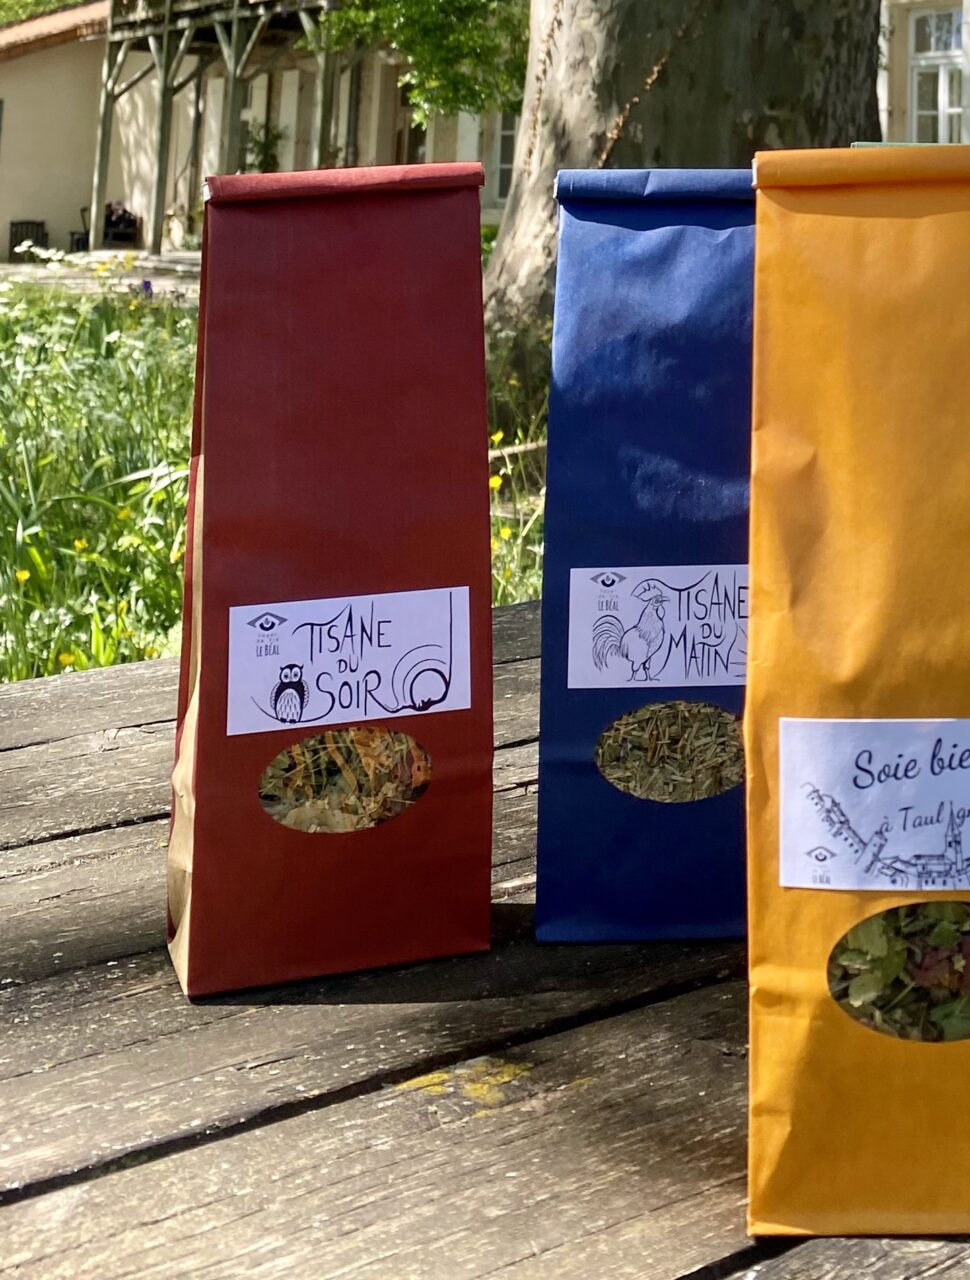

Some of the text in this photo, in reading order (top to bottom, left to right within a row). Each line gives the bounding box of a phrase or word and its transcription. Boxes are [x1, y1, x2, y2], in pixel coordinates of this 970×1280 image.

[670, 570, 749, 624] TISANE
[292, 601, 392, 663] TISANE
[660, 624, 735, 680] MATIN
[700, 622, 723, 639] DU
[337, 655, 359, 673] DU
[315, 669, 398, 716] SOIR
[852, 749, 921, 789] Soie
[880, 816, 893, 833] à
